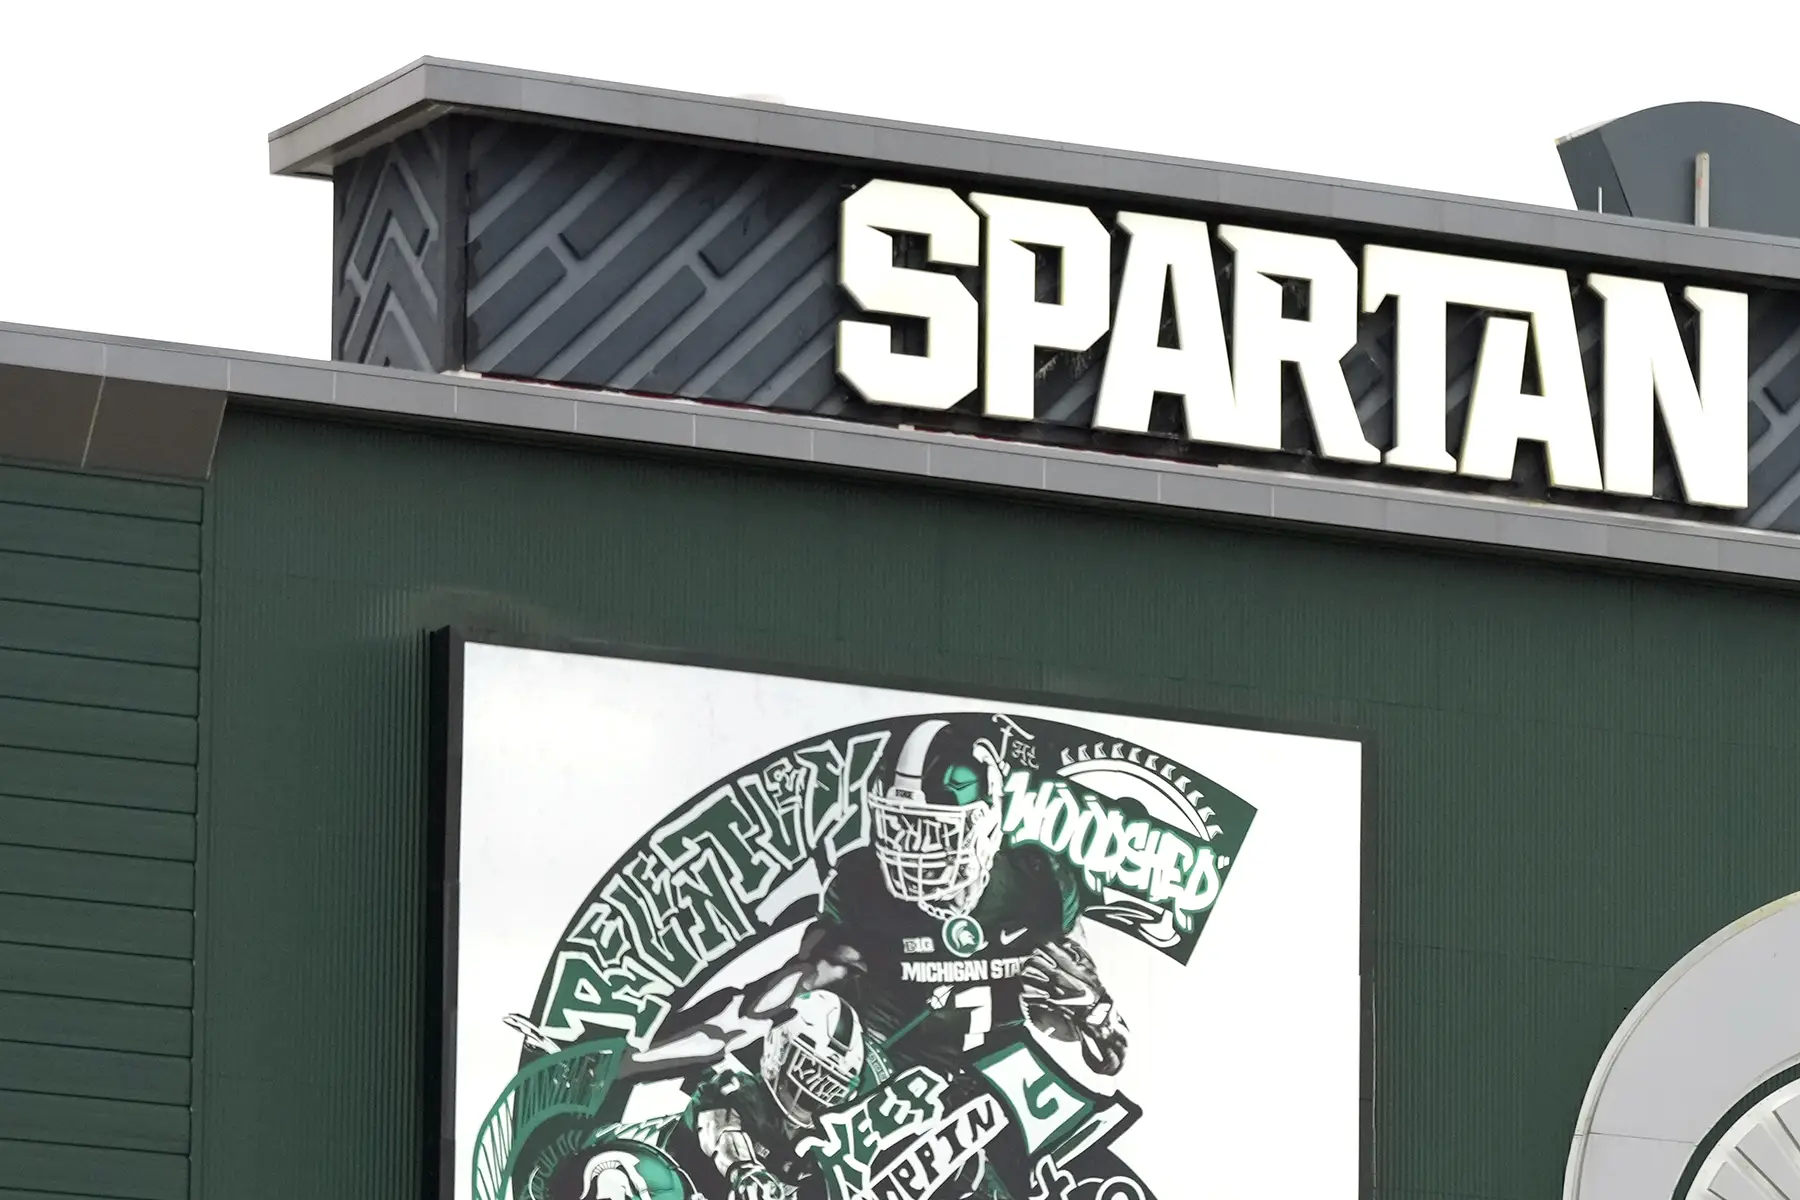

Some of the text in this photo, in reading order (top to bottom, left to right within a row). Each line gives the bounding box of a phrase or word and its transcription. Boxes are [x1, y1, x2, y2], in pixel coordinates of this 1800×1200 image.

[837, 177, 1749, 509] SPARTAN
[900, 956, 1032, 983] MICHIGAN STA
